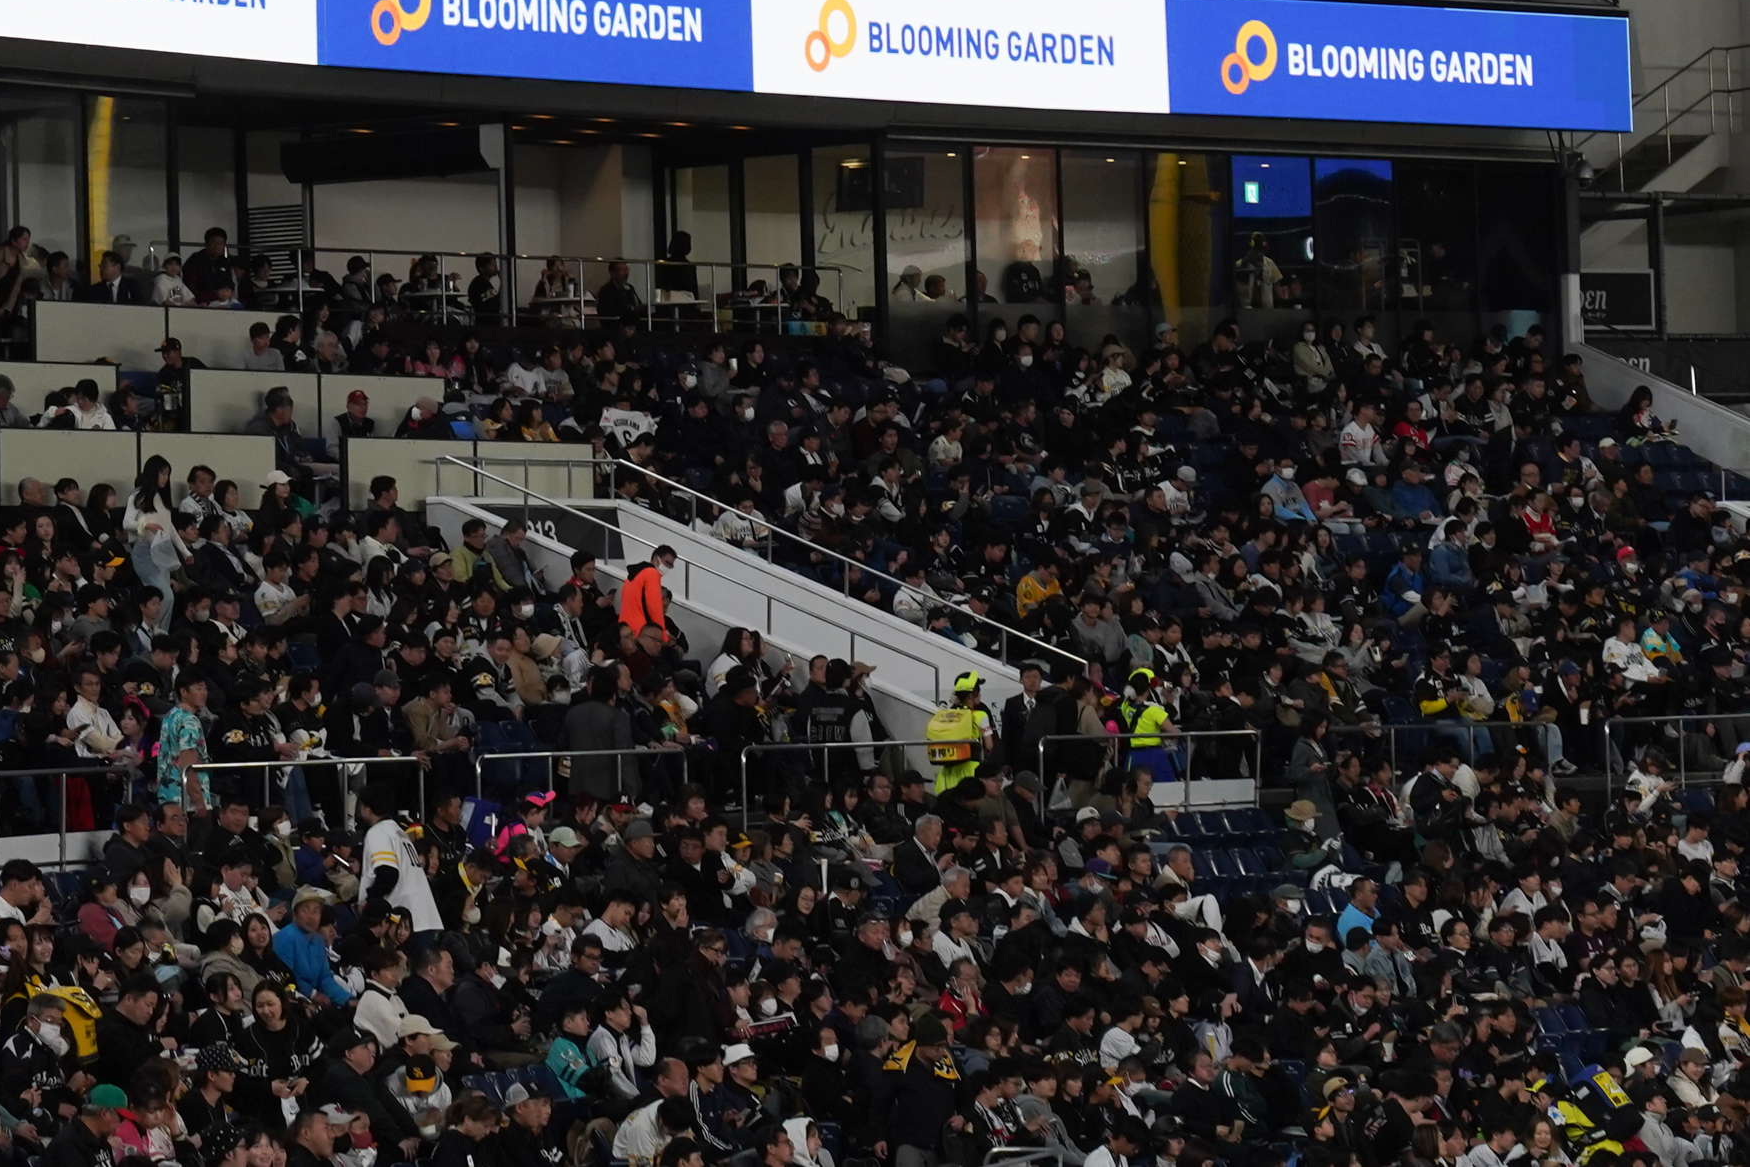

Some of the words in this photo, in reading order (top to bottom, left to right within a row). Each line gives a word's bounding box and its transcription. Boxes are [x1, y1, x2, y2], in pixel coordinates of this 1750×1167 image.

[593, 1, 703, 42] GARDEN
[868, 21, 1000, 61] BLOOMING
[1007, 31, 1115, 66] GARDEN
[1287, 43, 1425, 81] BLOOMING
[1430, 50, 1533, 86] GARDEN
